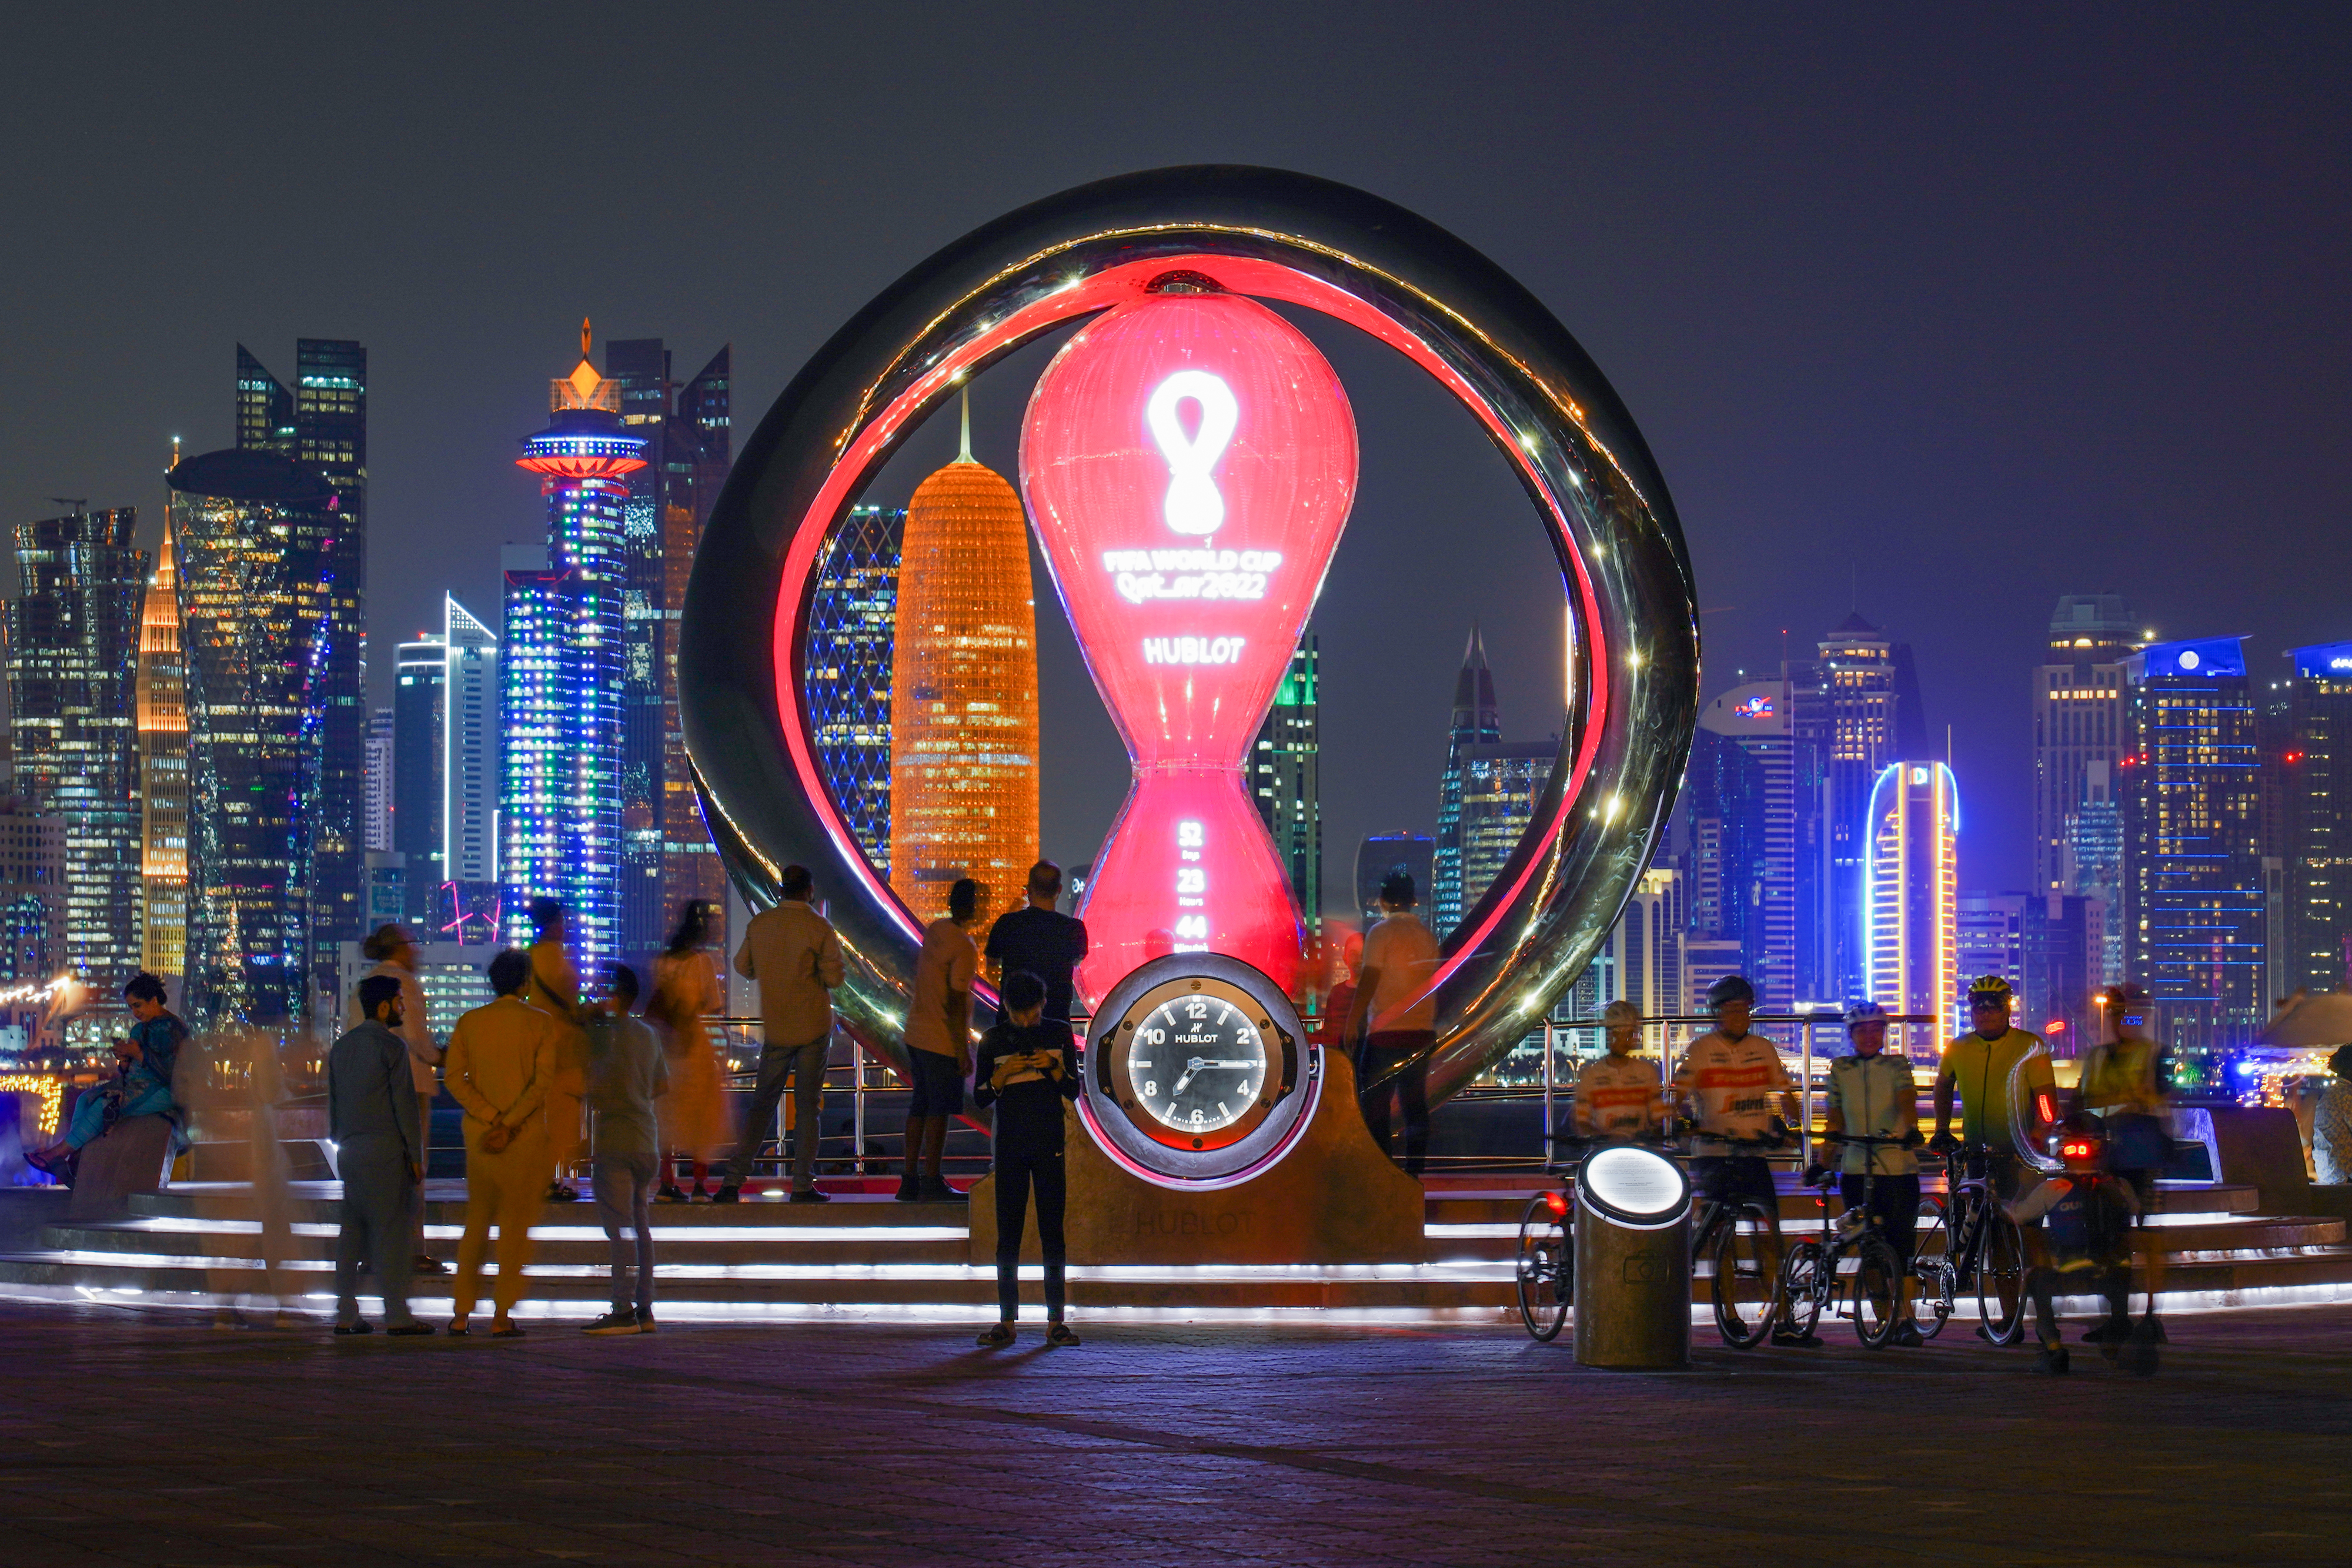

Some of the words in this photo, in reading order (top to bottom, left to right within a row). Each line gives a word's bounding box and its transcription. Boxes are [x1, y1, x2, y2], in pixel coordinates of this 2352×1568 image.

[1104, 551, 1152, 573] FIFA
[1152, 550, 1238, 571] WORLD
[1240, 550, 1282, 572] CUP
[1144, 637, 1245, 664] HUBLOT
[1179, 822, 1202, 846] 52
[1182, 850, 1200, 861] Days
[1177, 869, 1204, 892] 23
[1179, 897, 1204, 906] Hours
[1175, 915, 1207, 938] 44
[1174, 942, 1209, 954] Minutes
[1185, 1002, 1207, 1019] 12
[1143, 1028, 1165, 1045] 10
[1175, 1034, 1218, 1044] HUBLOT
[1236, 1028, 1250, 1045] 2
[1144, 1080, 1157, 1096] 8
[1237, 1079, 1250, 1096] 4
[1191, 1109, 1204, 1125] 6
[1135, 1210, 1257, 1235] HUBLOT
